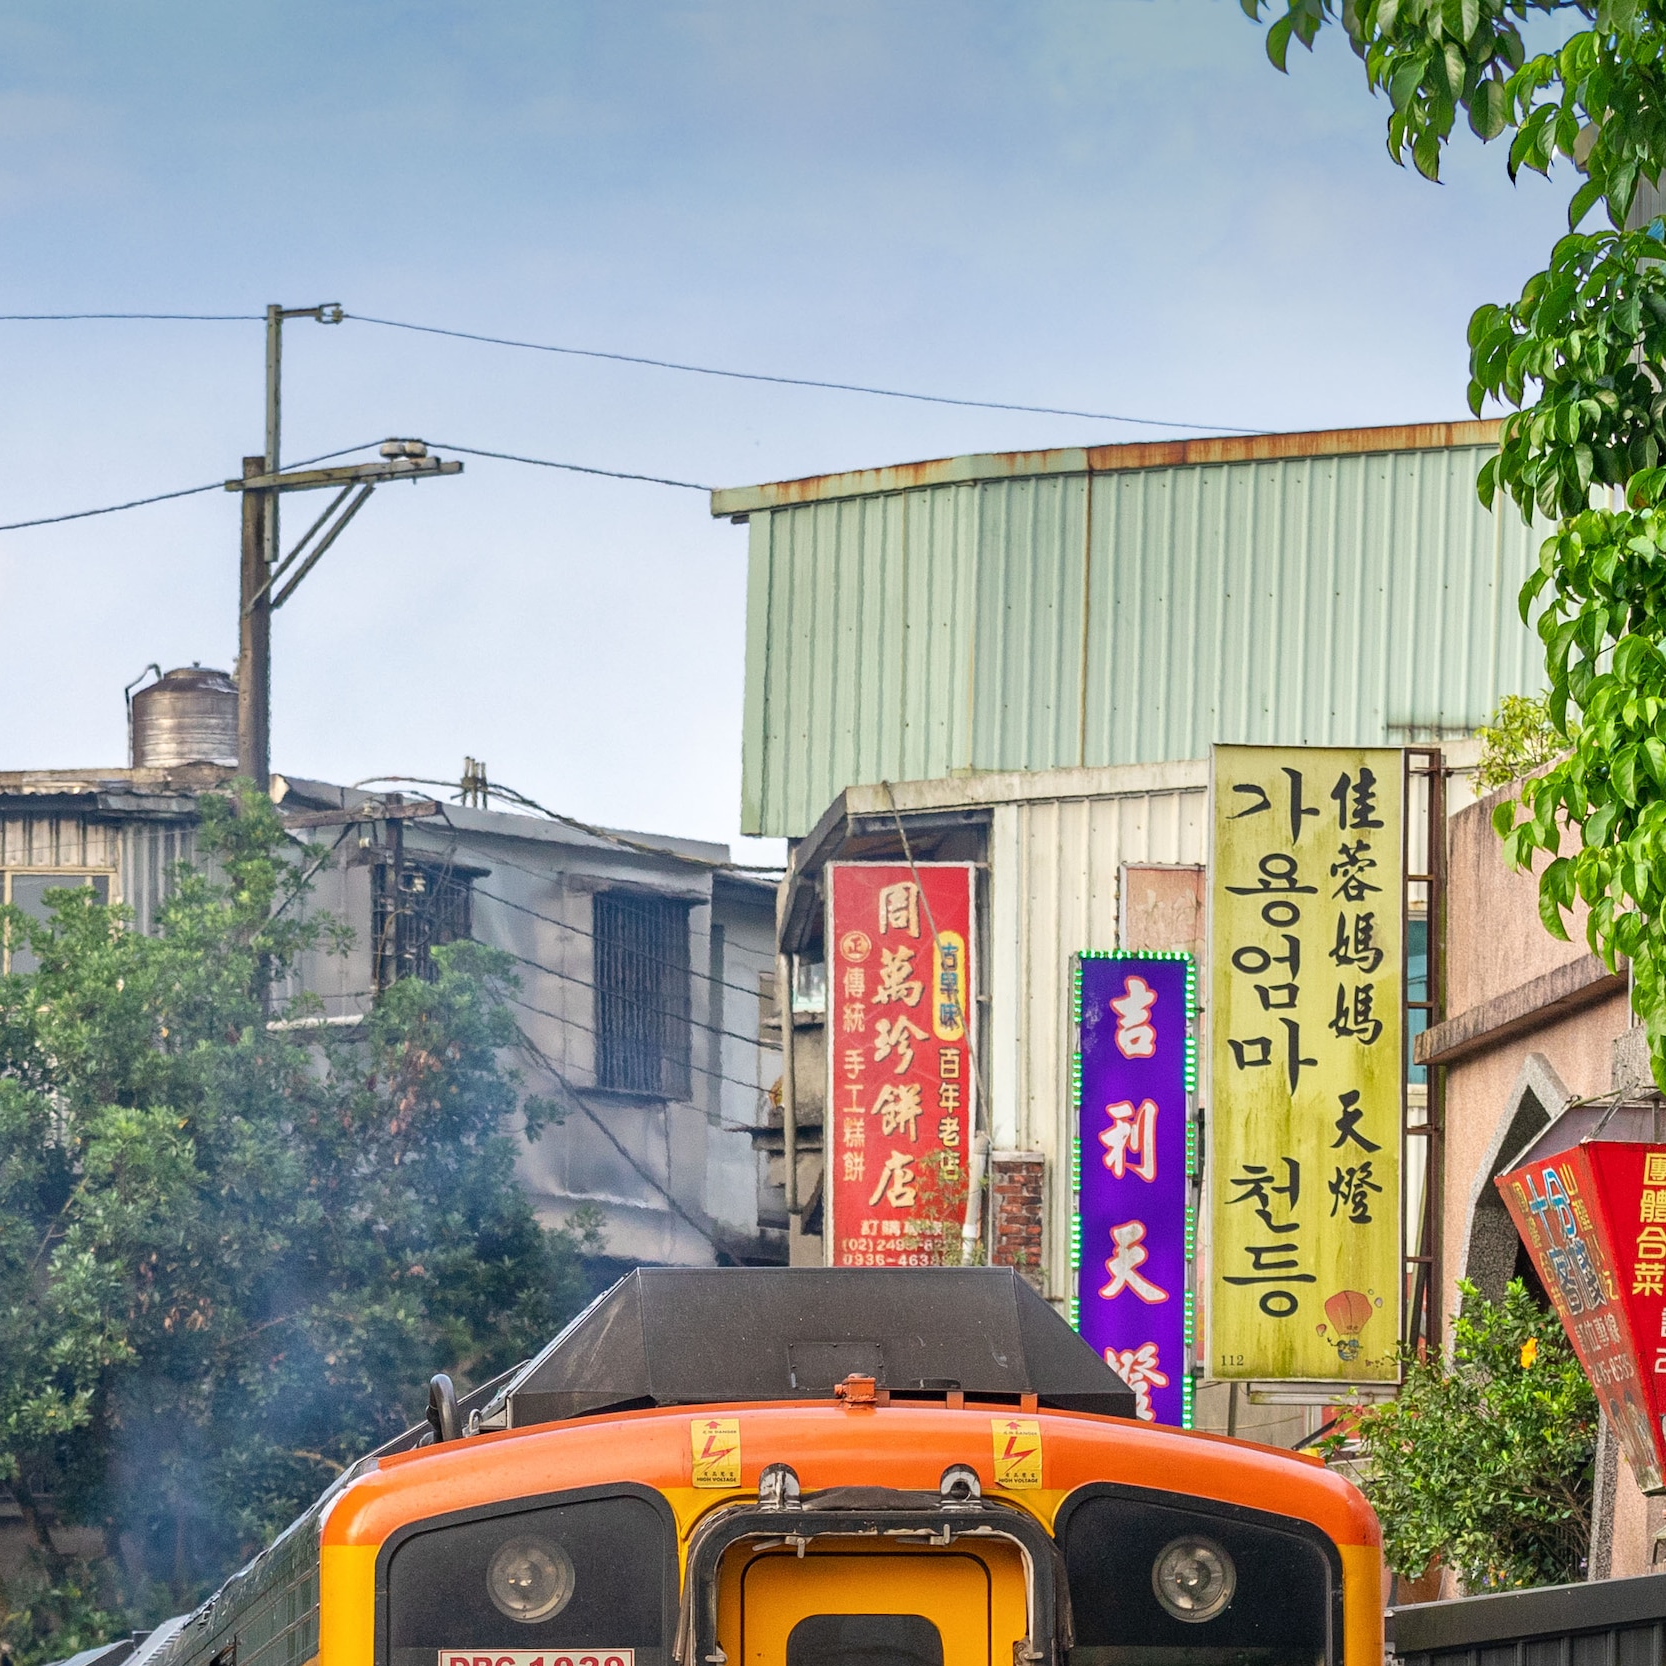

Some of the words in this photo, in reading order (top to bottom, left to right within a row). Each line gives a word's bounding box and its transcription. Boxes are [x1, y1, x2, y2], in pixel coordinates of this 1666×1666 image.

[1224, 766, 1321, 1099] 가용엄마
[1328, 767, 1385, 1047] 佳蓉媽媽
[842, 967, 866, 1034] 傳統
[868, 881, 930, 1208] 周萬珍餅店
[938, 942, 962, 1031] 古早味
[842, 1049, 866, 1182] 手工糕餅
[937, 1047, 962, 1182] 百年老店
[1327, 1090, 1384, 1225] 天燈
[1222, 1156, 1320, 1319] 천등
[1220, 1354, 1245, 1367] 112
